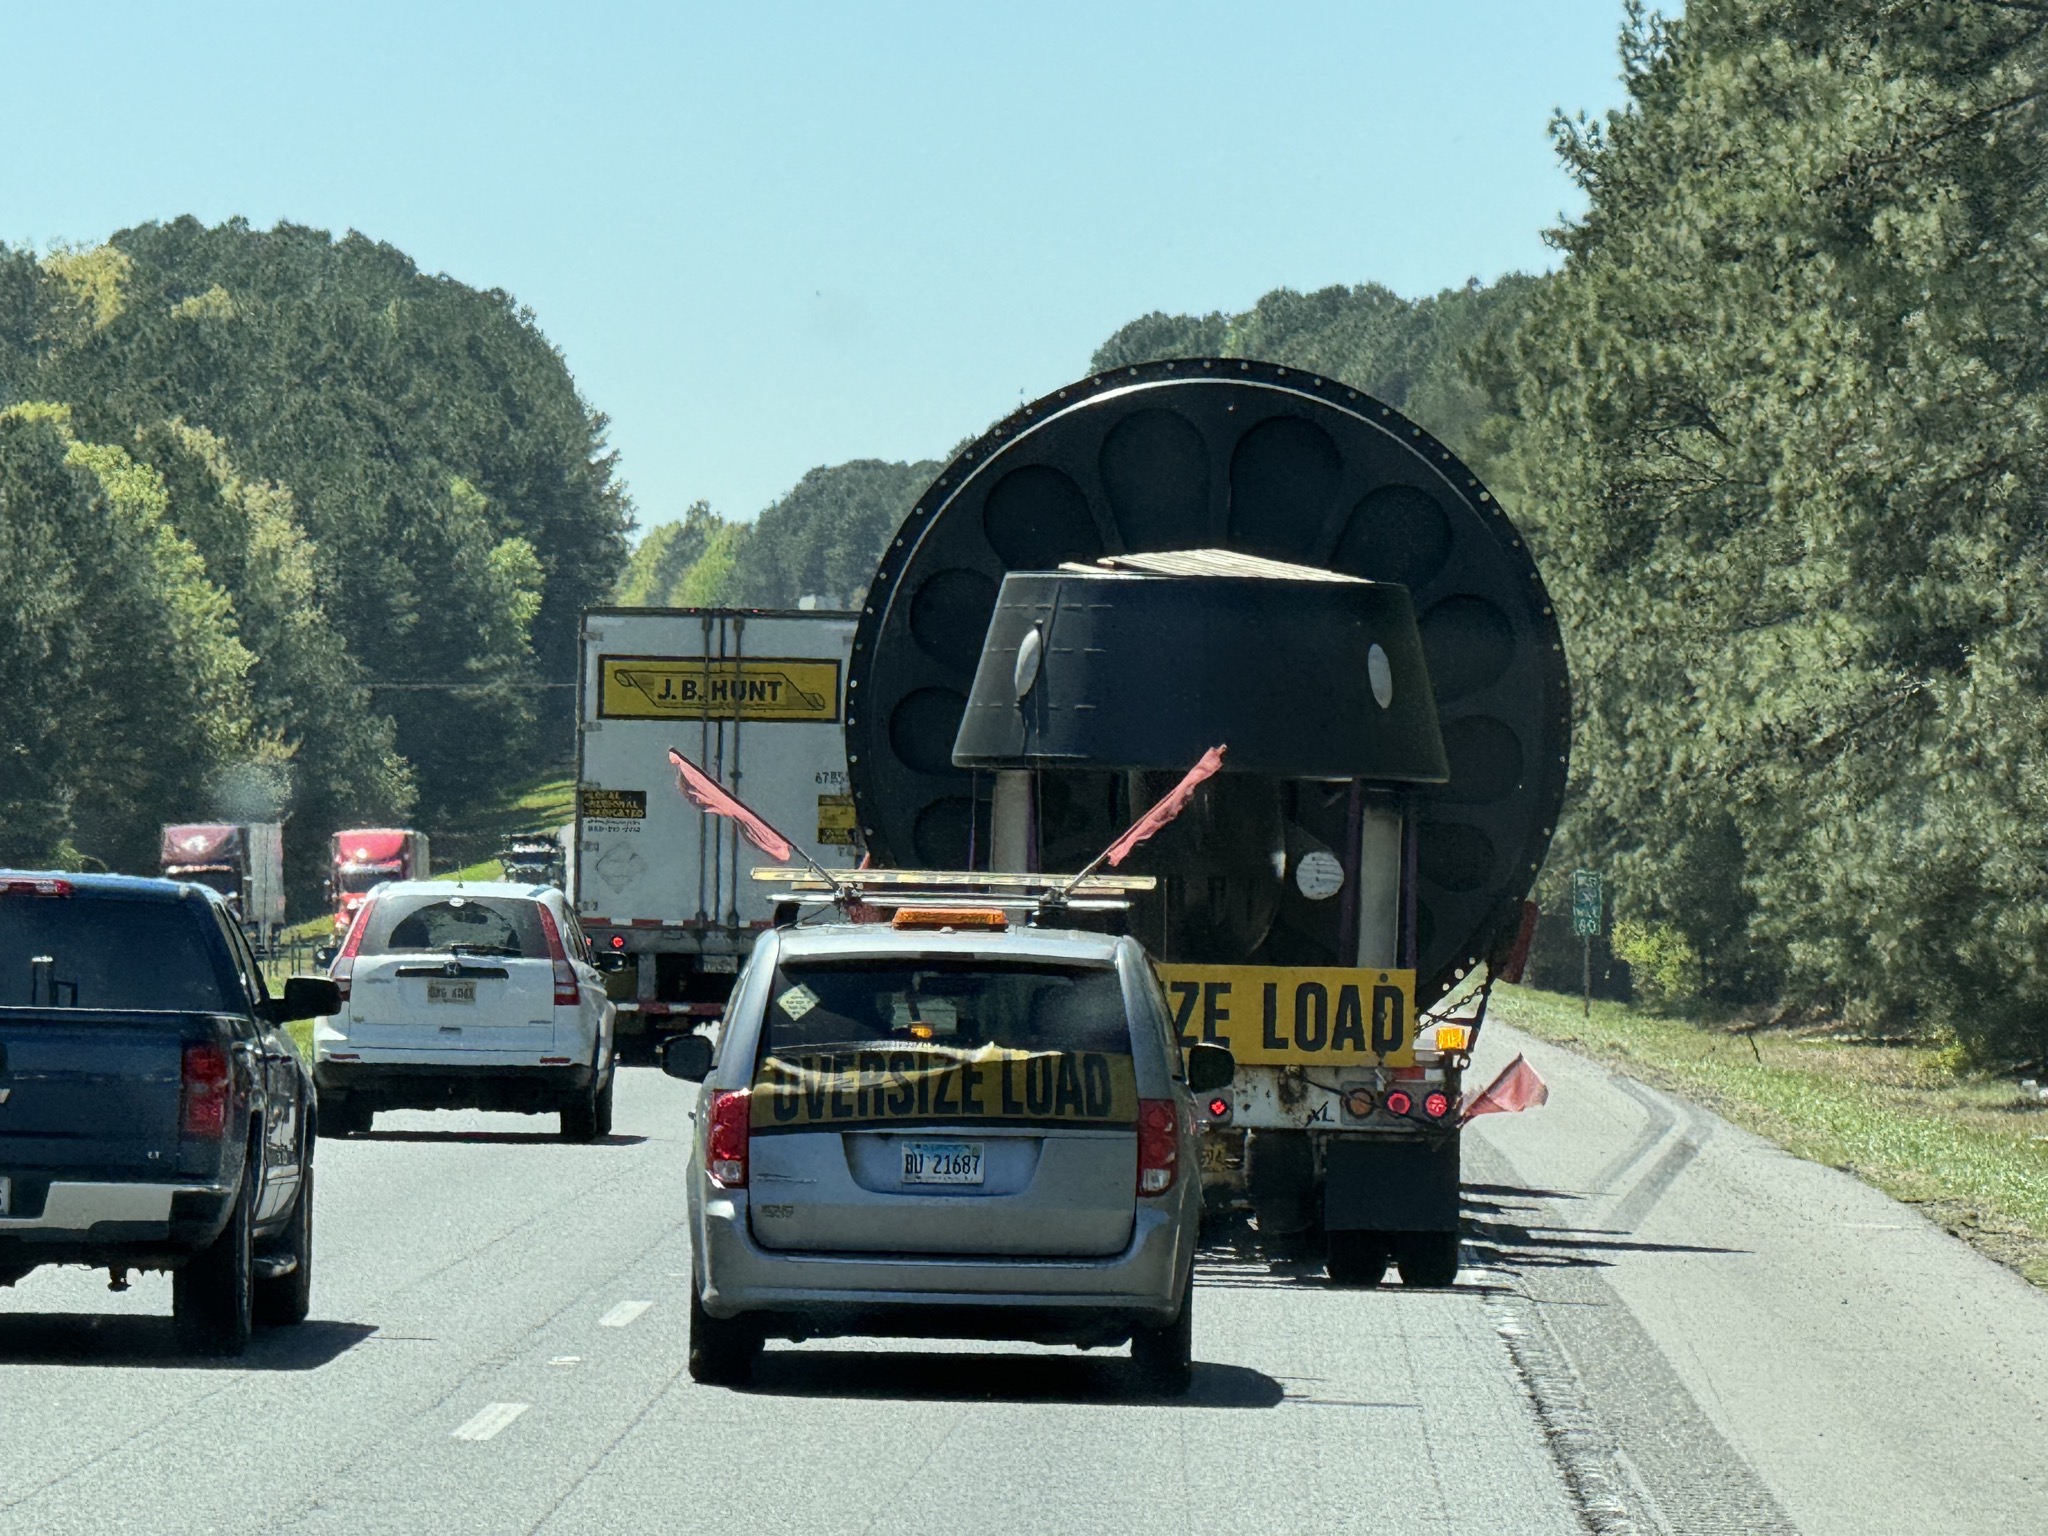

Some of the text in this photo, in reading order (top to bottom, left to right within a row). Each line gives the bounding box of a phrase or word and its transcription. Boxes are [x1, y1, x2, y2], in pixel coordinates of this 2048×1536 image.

[711, 680, 782, 701] HUNT
[1263, 982, 1403, 1052] LOAD
[773, 1050, 1112, 1121] OVERSIZE LOAD
[933, 1153, 980, 1175] 21687
